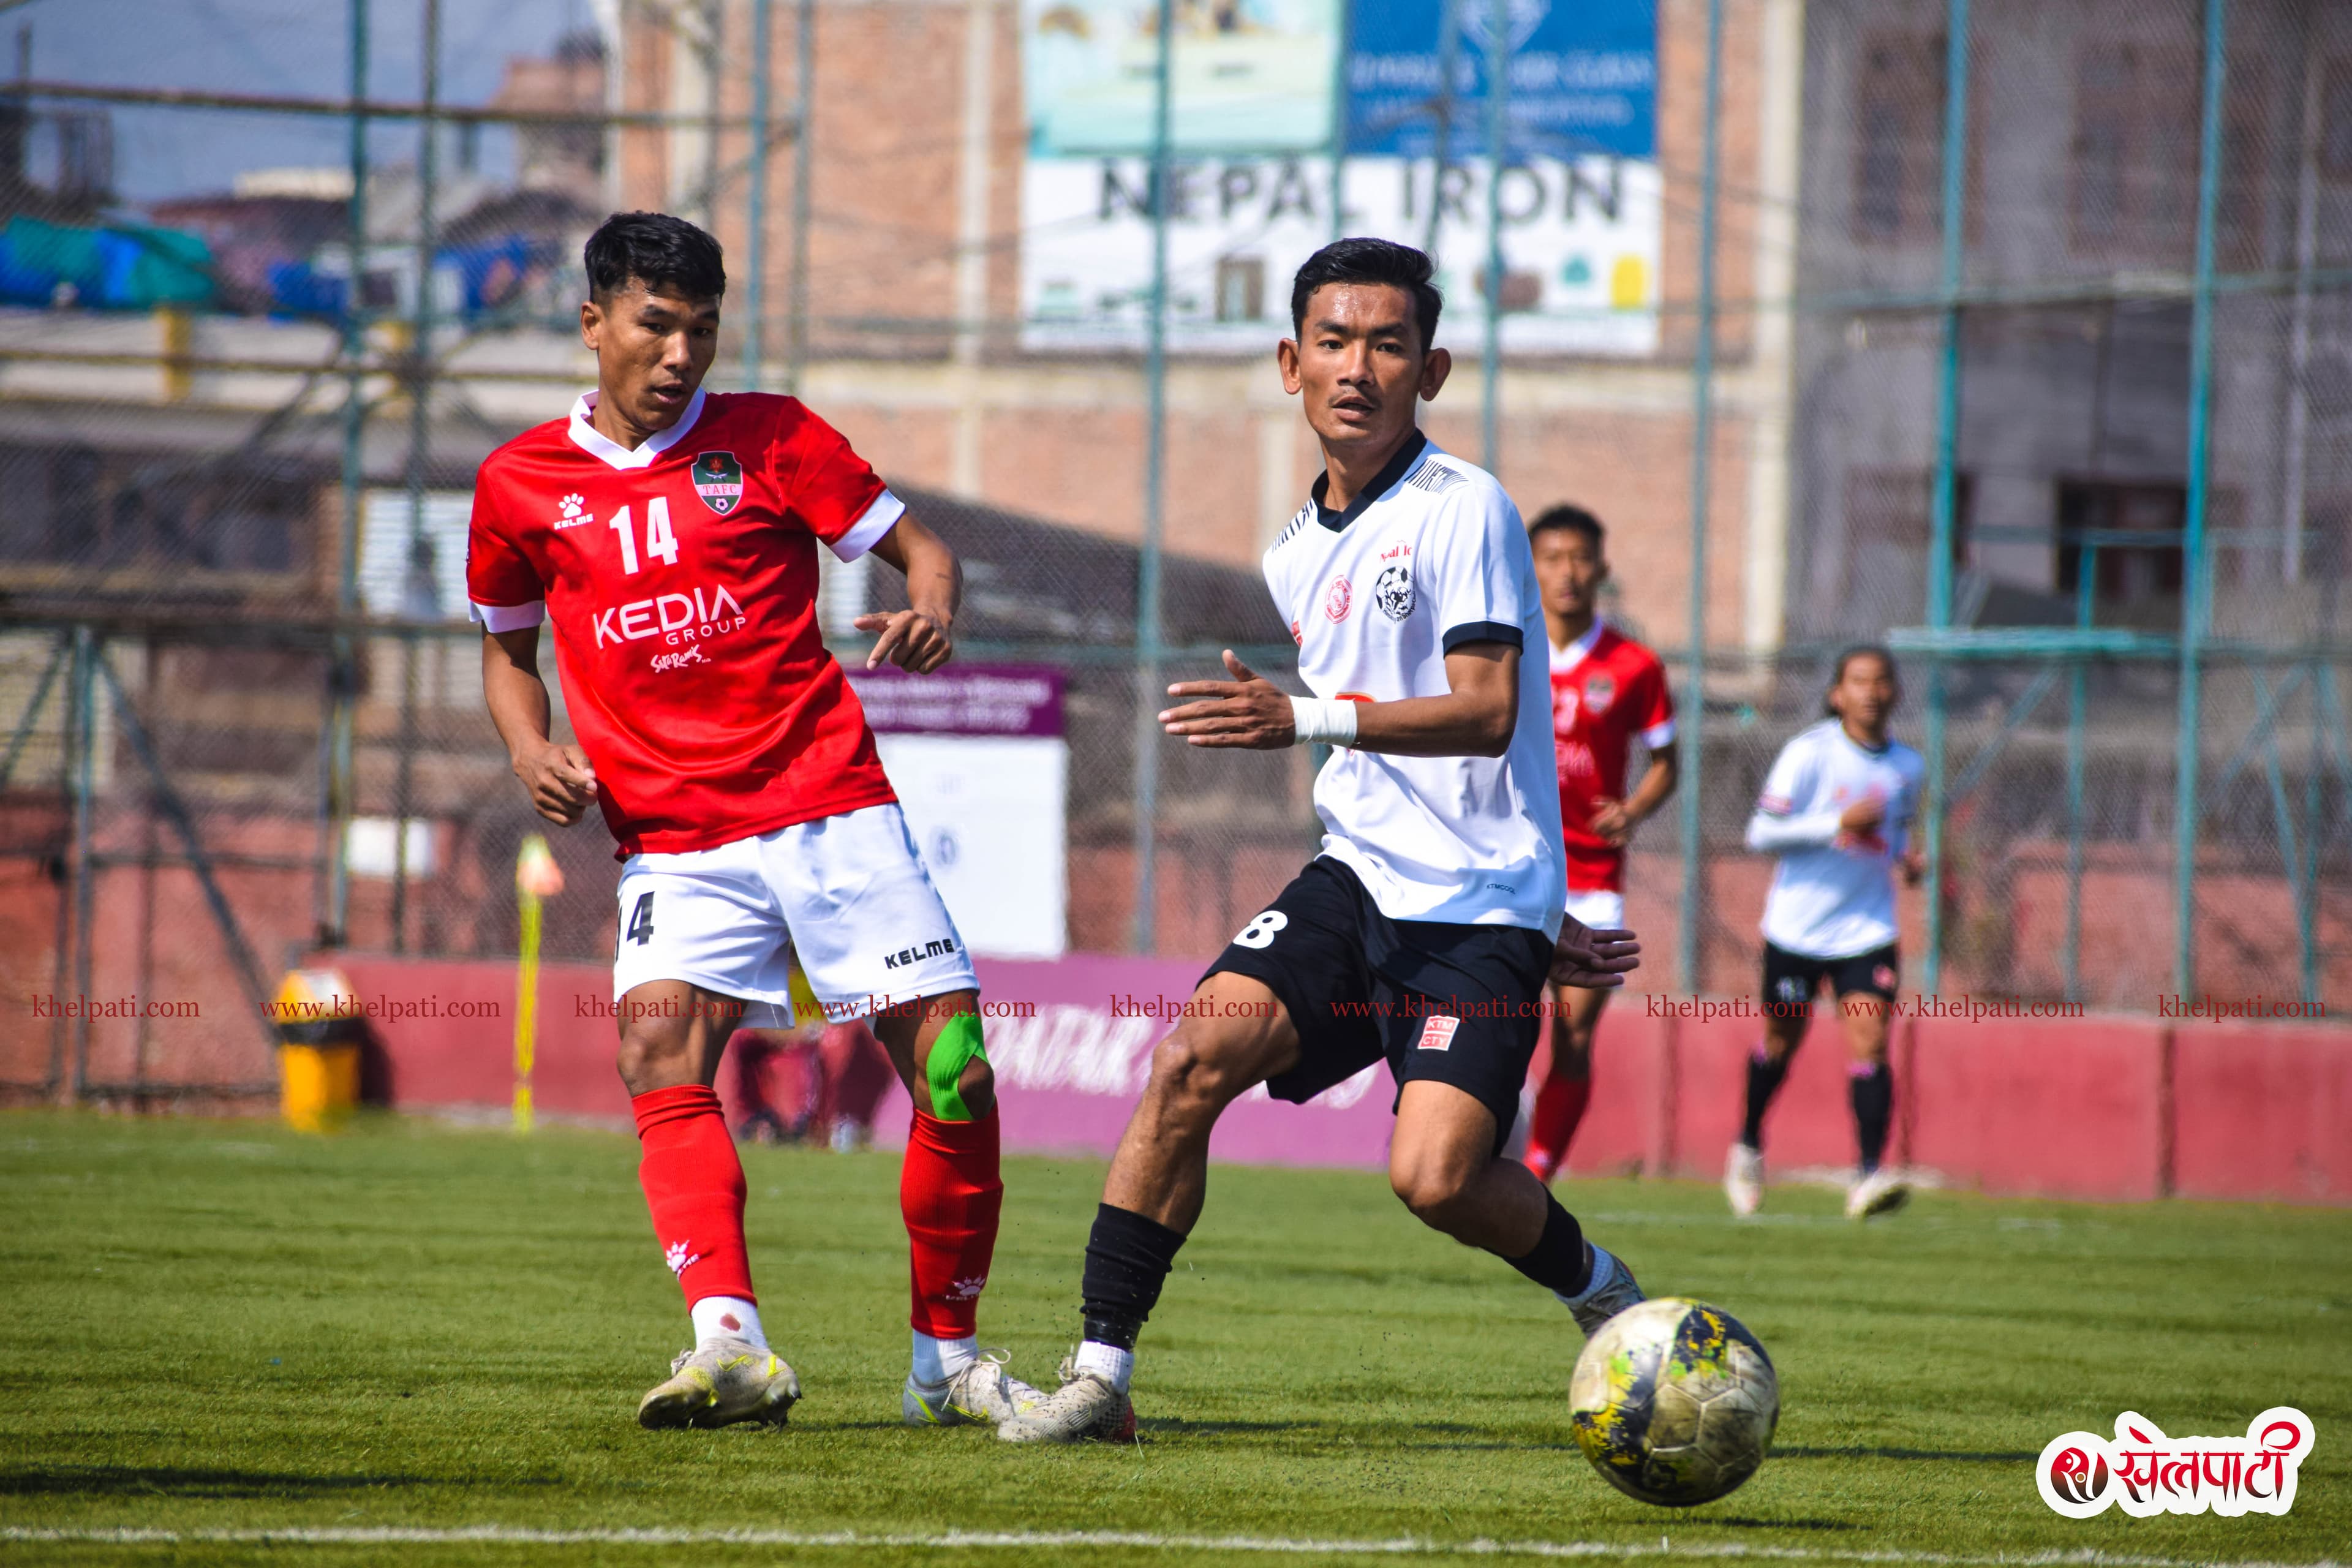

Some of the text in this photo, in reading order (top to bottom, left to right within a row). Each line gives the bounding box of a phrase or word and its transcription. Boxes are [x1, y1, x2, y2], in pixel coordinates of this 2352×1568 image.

[1401, 160, 1622, 222] IRON
[703, 484, 737, 495] TAFC
[554, 513, 594, 530] KELME
[609, 497, 679, 575] 14
[593, 584, 744, 649] KEDIA
[666, 617, 746, 646] GROUP
[1233, 910, 1288, 949] 8
[884, 938, 955, 969] KELME
[1428, 1020, 1453, 1030] KTM
